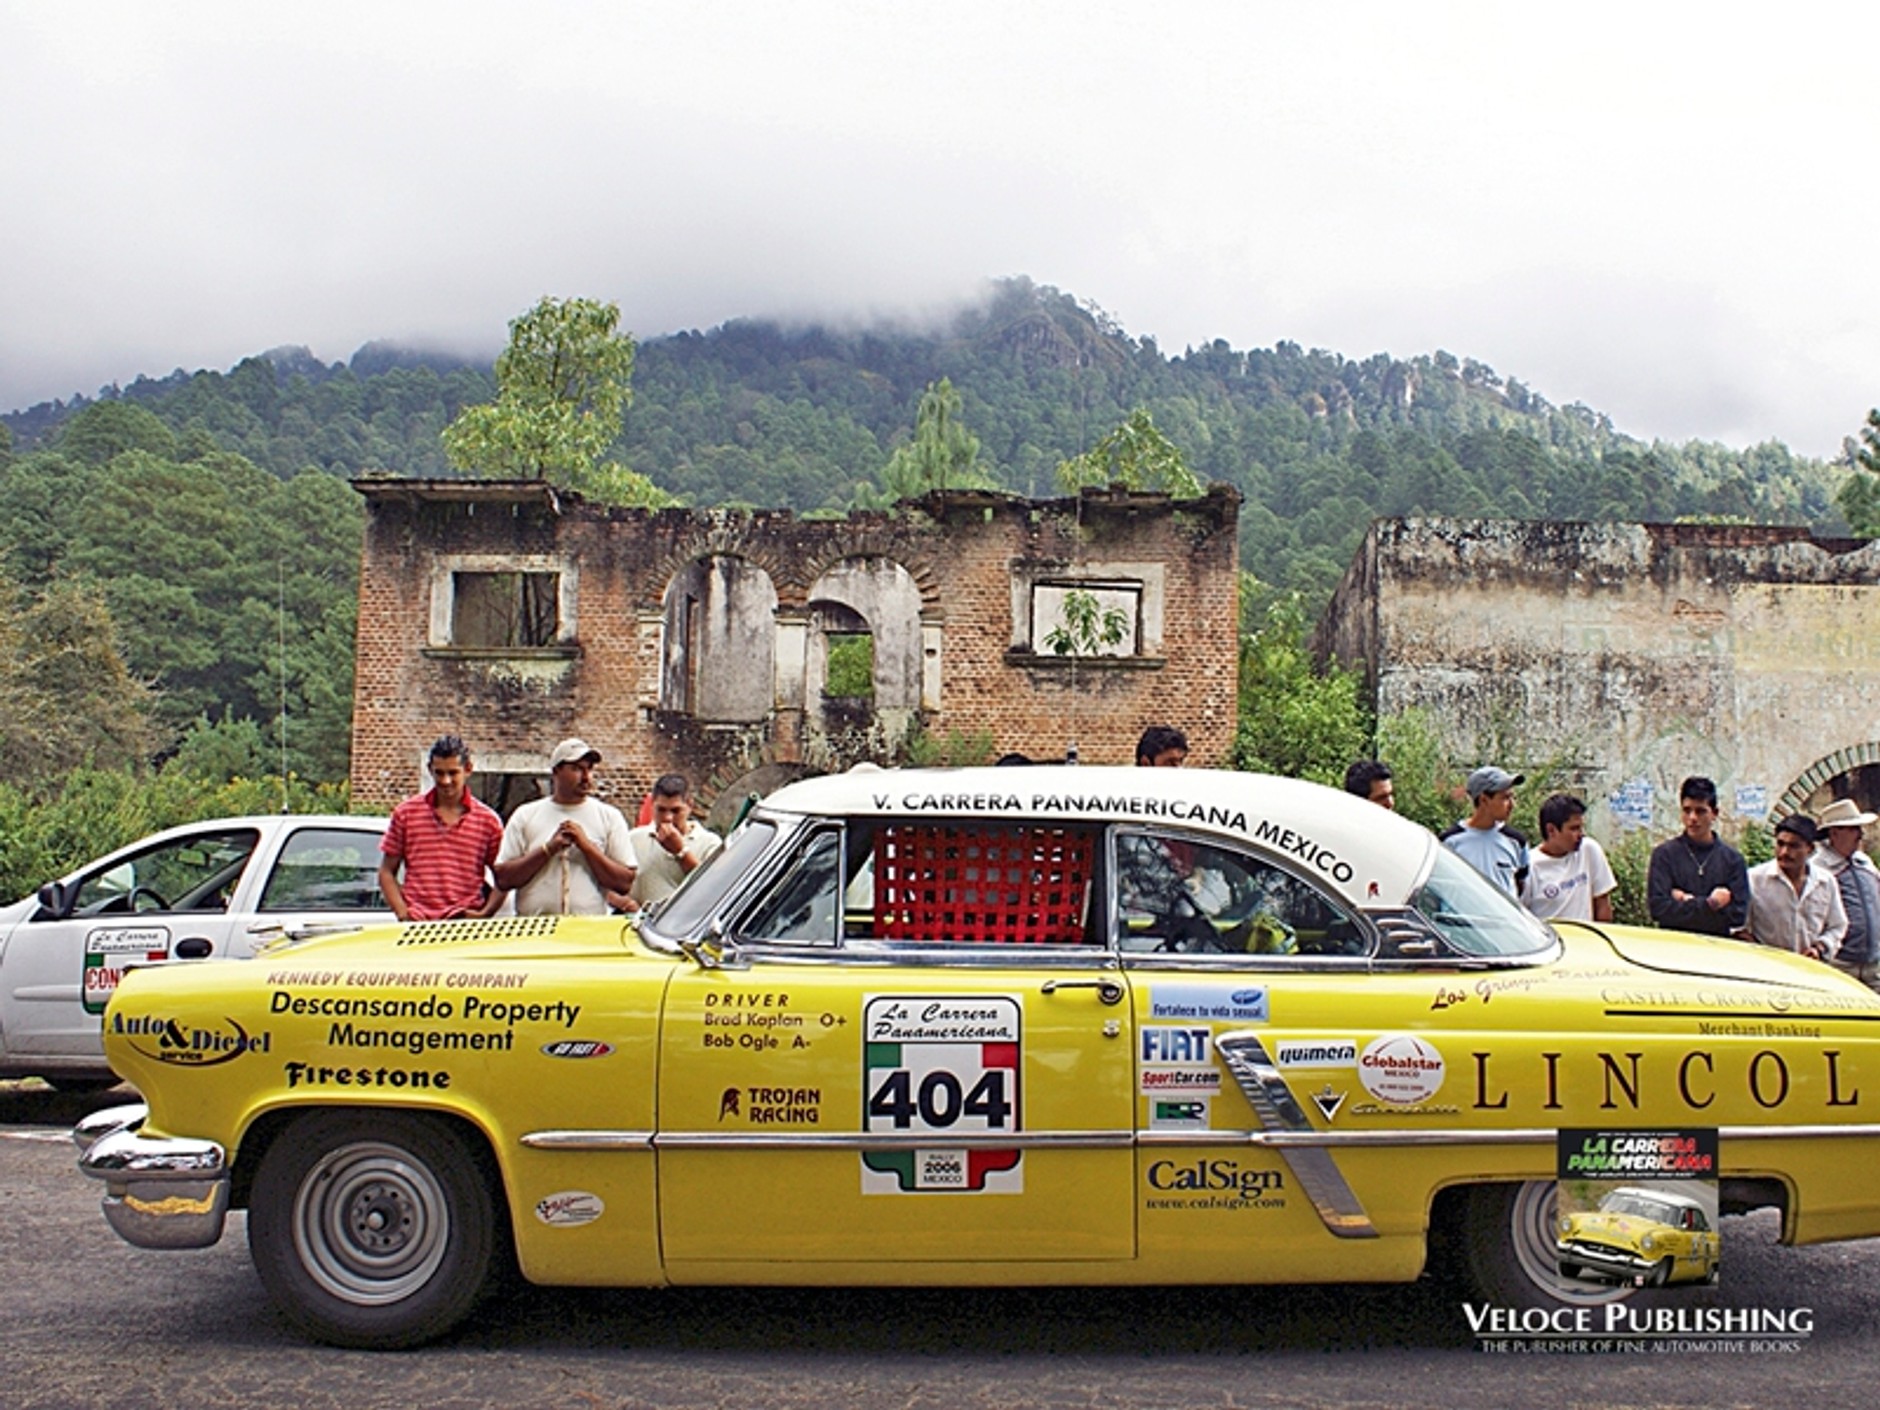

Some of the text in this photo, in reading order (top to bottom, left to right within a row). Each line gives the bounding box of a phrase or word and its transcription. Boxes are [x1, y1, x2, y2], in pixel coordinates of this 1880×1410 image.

[902, 794, 1022, 810] CARRERA
[1031, 794, 1247, 832] PANAMERICANA
[1255, 820, 1353, 883] MEXICO
[267, 971, 529, 988] KENNEDY EQUIPMENT COMPANY
[270, 991, 581, 1028] Descansando Property
[705, 994, 789, 1007] DRIVER
[880, 1003, 998, 1022] La Carrera
[1154, 1004, 1196, 1016] Fortalece
[1211, 1006, 1230, 1017] vida
[705, 1012, 741, 1026] Brad
[747, 1013, 803, 1029] Kaplan
[328, 1023, 514, 1054] Management
[1699, 1022, 1820, 1038] Merchant Banking
[704, 1034, 734, 1047] Bob
[739, 1034, 779, 1051] Ogle
[1142, 1030, 1209, 1061] FIAT
[1279, 1046, 1356, 1064] quimera
[1362, 1055, 1442, 1070] Globalstar
[285, 1062, 450, 1088] Firestone
[748, 1088, 820, 1106] TROJAN
[869, 1070, 1011, 1129] 404
[750, 1107, 819, 1123] RACING
[1148, 1160, 1284, 1199] CalSign
[1147, 1197, 1285, 1210] www.calsign.com
